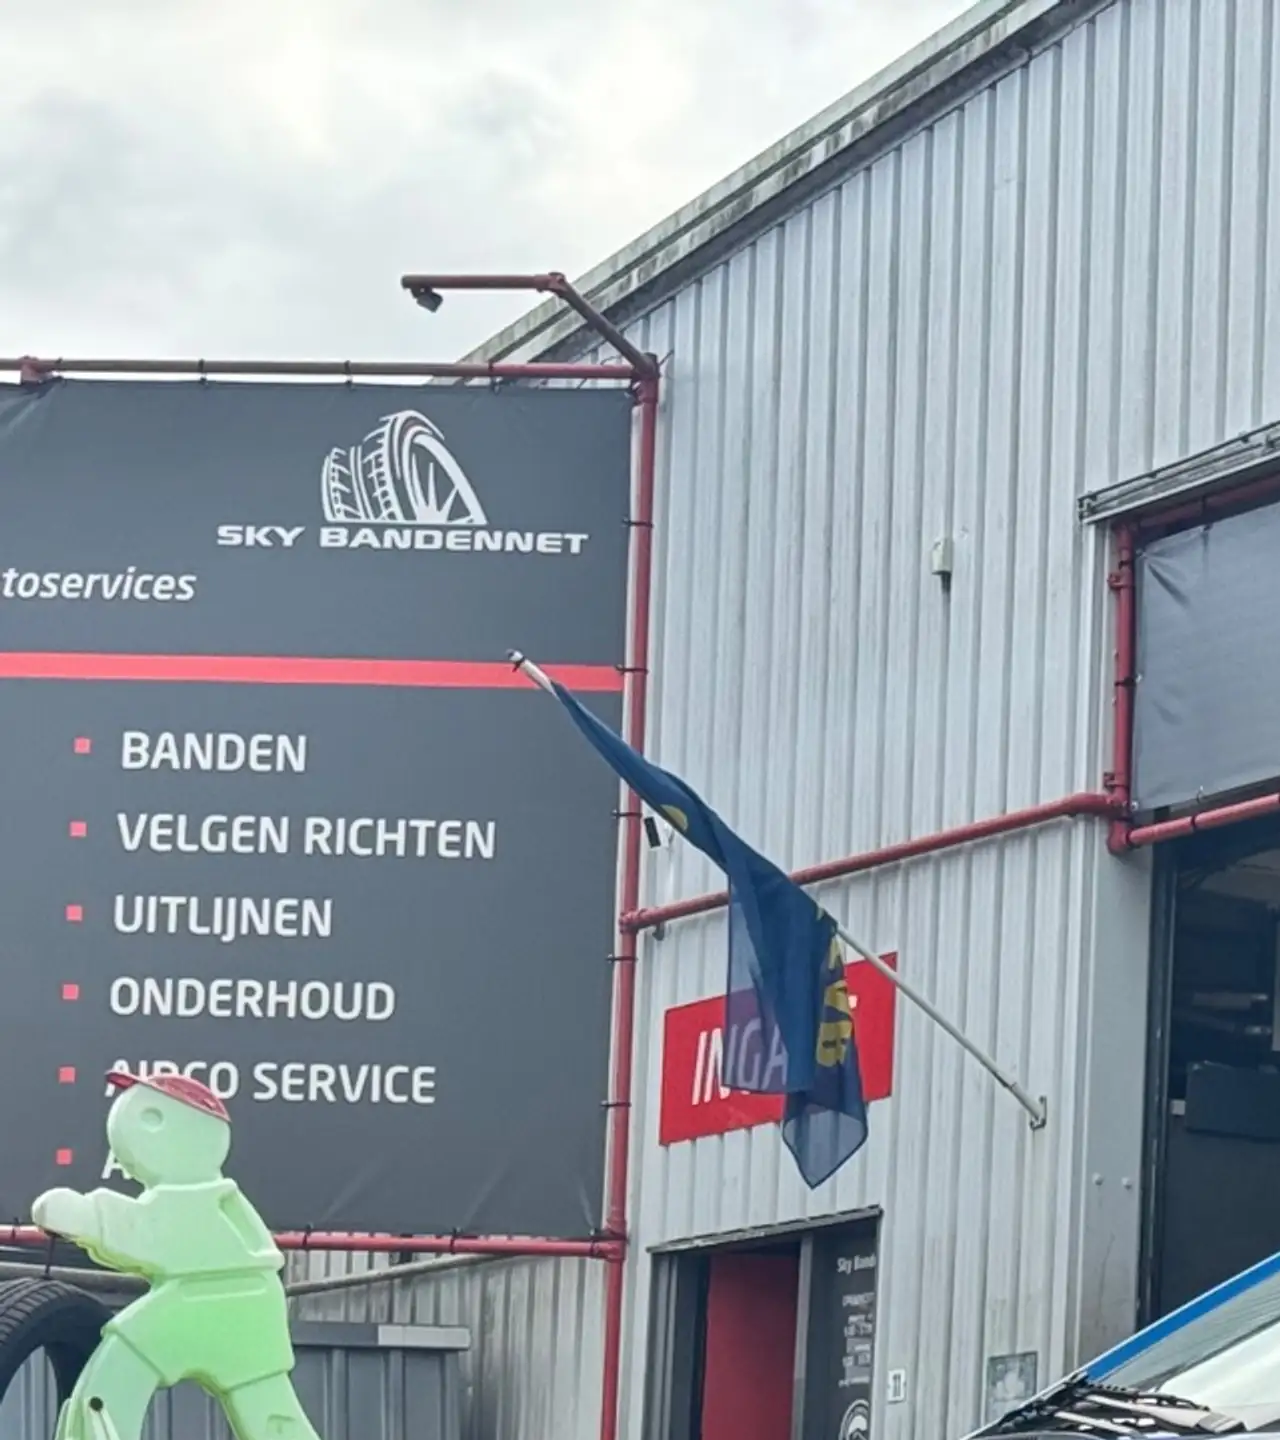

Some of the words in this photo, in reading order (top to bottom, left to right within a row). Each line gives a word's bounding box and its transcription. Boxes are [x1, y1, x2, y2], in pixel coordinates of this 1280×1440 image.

[217, 525, 305, 547] SKY
[320, 526, 588, 555] BANDENNET
[121, 730, 306, 771] BANDEN
[117, 813, 289, 854] VELGEN
[303, 817, 496, 859] RICHTEN
[113, 895, 332, 941] UITLIJNEN
[109, 976, 395, 1020] ONDERHOUD
[253, 1062, 436, 1103] SERVICE
